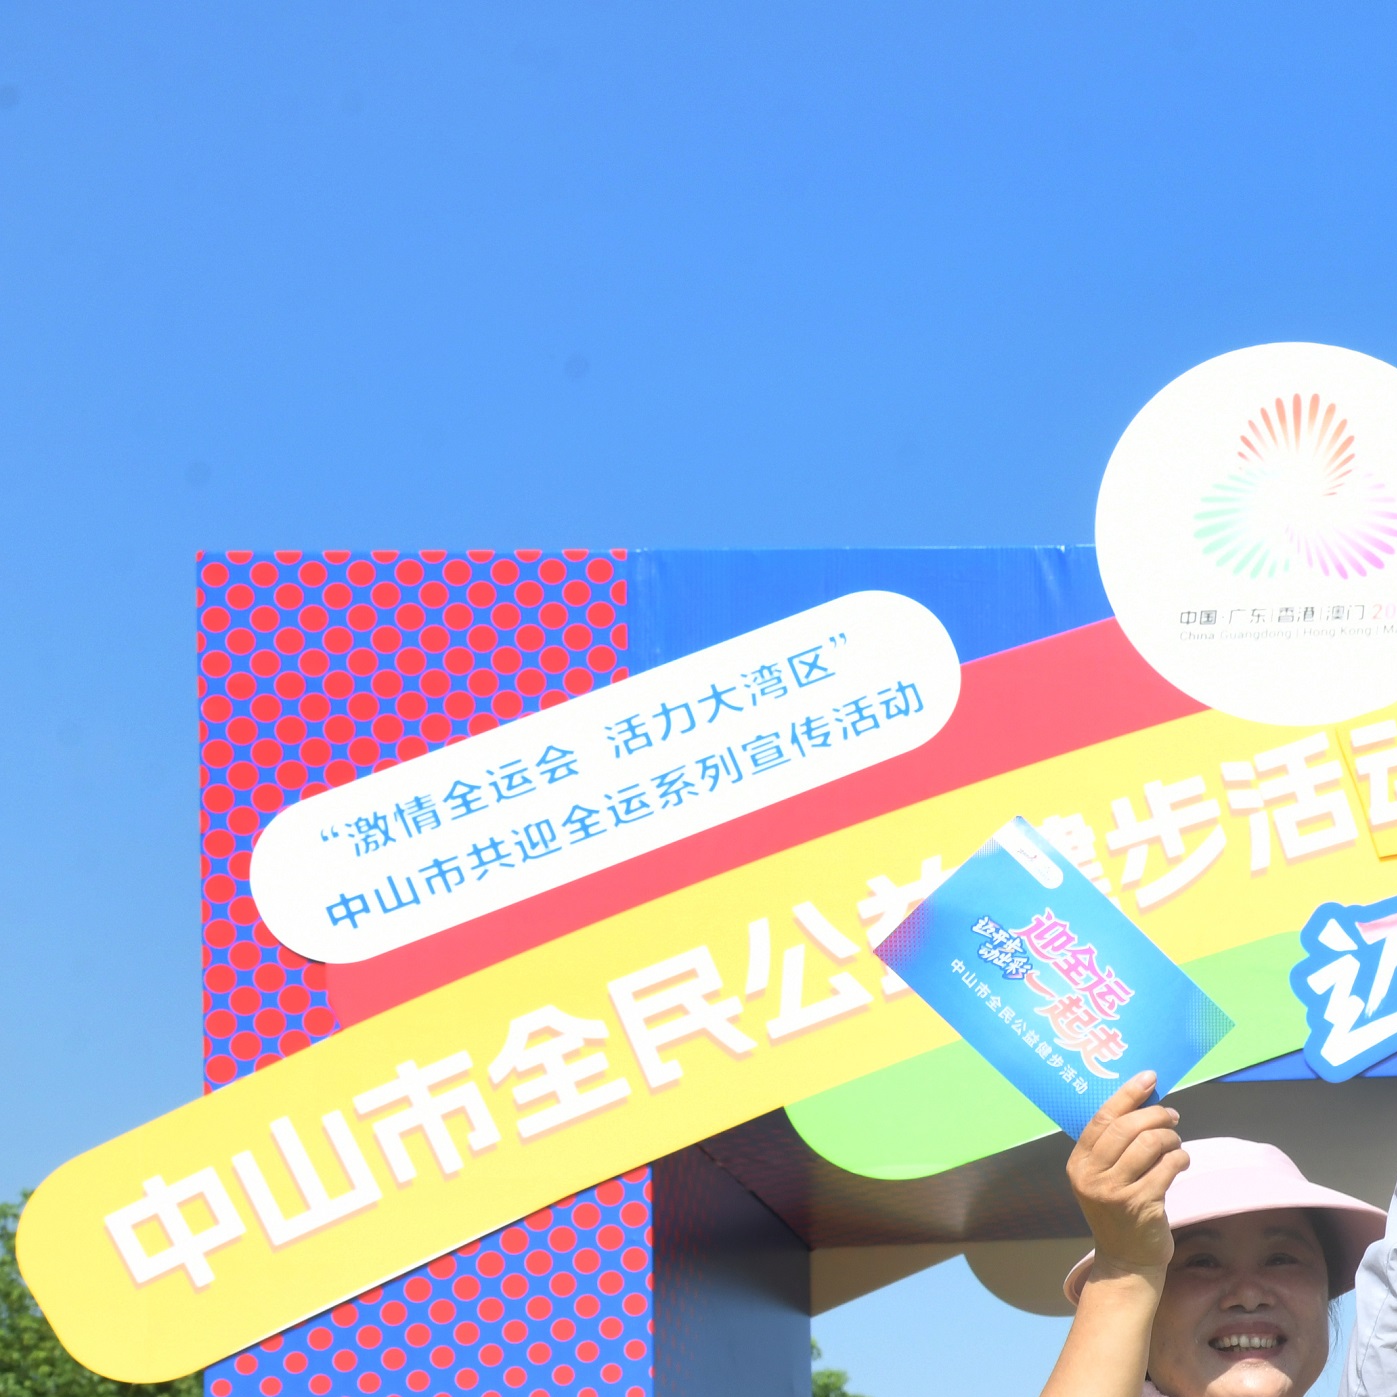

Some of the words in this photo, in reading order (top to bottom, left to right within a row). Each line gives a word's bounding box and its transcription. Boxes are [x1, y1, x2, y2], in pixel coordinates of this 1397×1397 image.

[1179, 629, 1215, 642] China
[1303, 626, 1336, 639] Hong
[1340, 625, 1372, 638] Kong
[325, 680, 927, 931] 中山市共迎全运系列宣传活动
[1013, 907, 1136, 1020] 迎全运
[949, 957, 1090, 1096] 中山市全民公益健步活动
[1026, 970, 1130, 1080] 一起走
